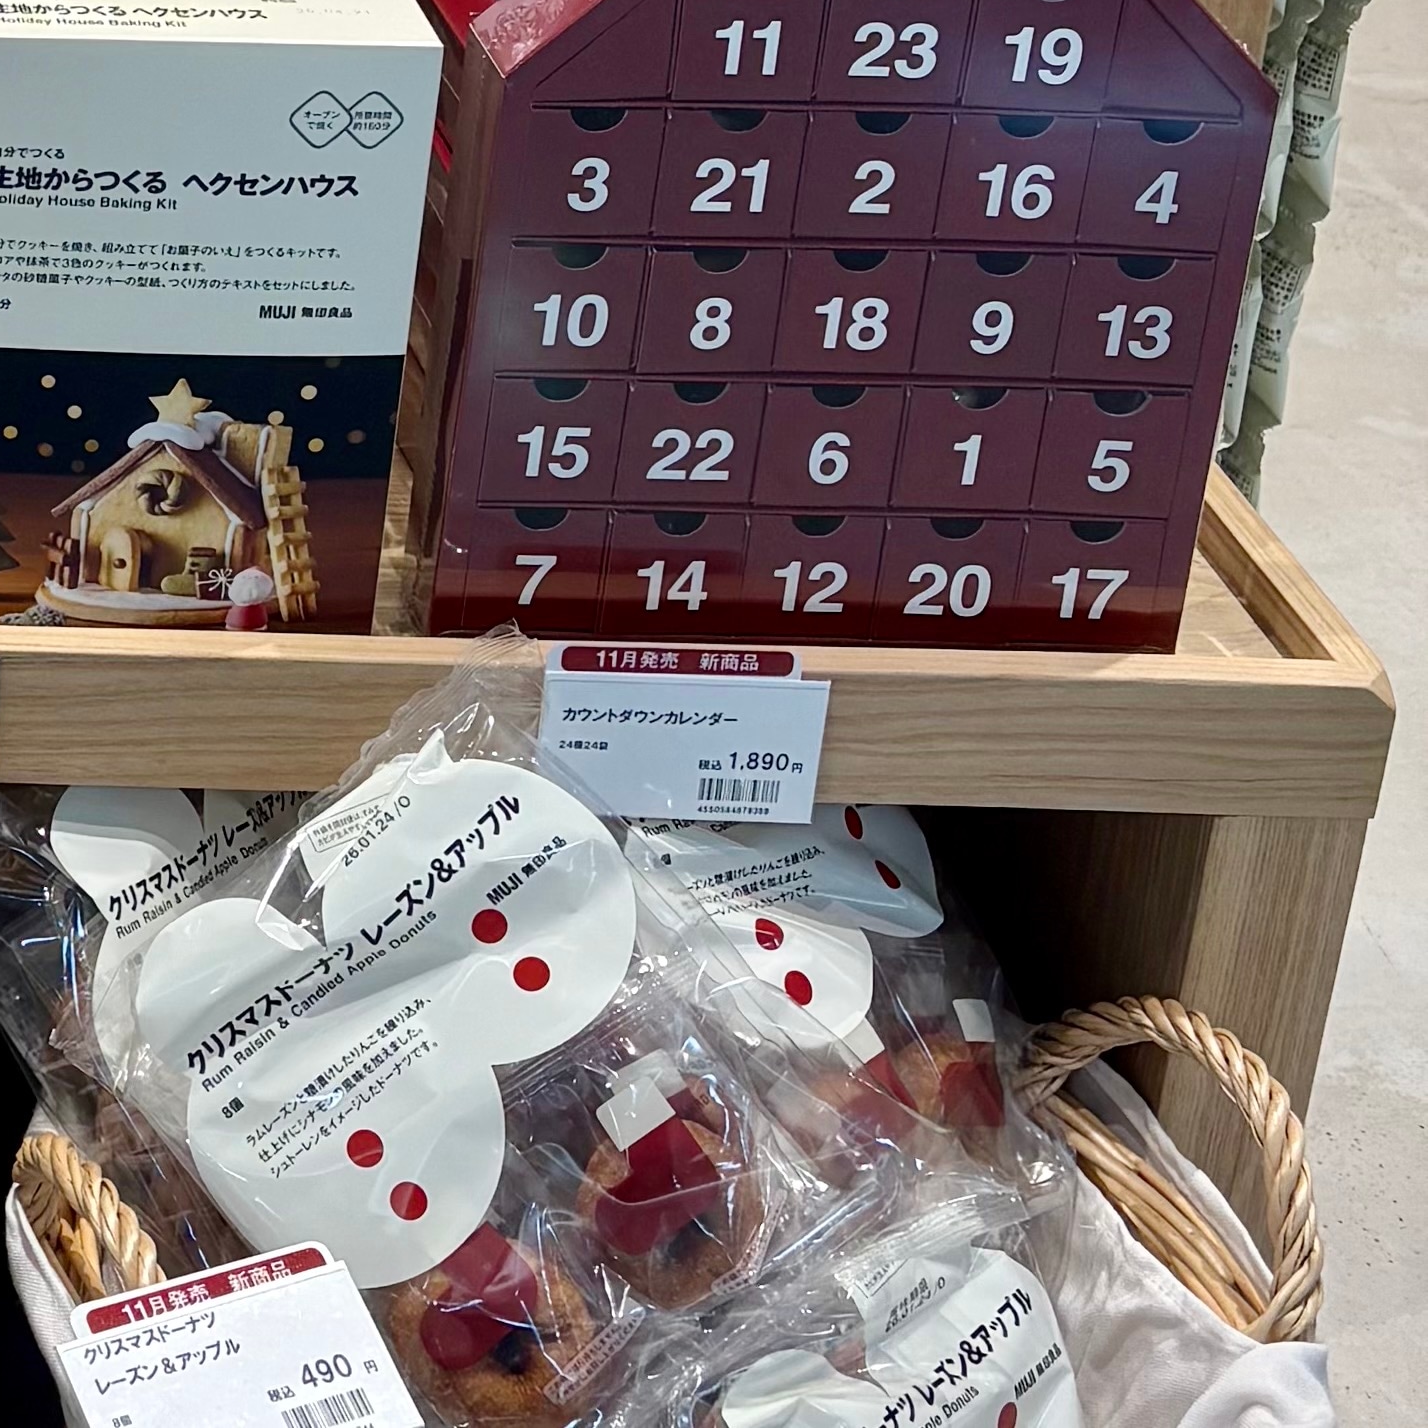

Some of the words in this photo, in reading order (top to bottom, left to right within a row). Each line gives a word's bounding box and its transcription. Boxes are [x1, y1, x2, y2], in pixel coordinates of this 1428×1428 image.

[714, 20, 783, 76] 11
[848, 22, 939, 79] 23
[1004, 26, 1084, 85] 19
[182, 169, 359, 199] ヘクセンハウス
[566, 157, 611, 213] 3
[690, 158, 773, 213] 21
[848, 160, 896, 214] 2
[977, 163, 1055, 220] 16
[1133, 170, 1180, 225] 4
[260, 304, 296, 320] MUJI
[533, 294, 609, 349] 10
[689, 298, 733, 351] 8
[813, 297, 889, 351] 18
[969, 300, 1015, 355] 9
[1097, 304, 1173, 359] 13
[514, 425, 591, 479] 15
[645, 428, 735, 482] 22
[807, 431, 851, 484] 6
[953, 434, 983, 486] 1
[1086, 439, 1133, 493] 5
[514, 555, 557, 605] 7
[637, 560, 708, 611] 14
[773, 560, 849, 614] 12
[903, 563, 993, 617] 20
[1050, 567, 1130, 620] 17
[596, 649, 680, 672] 11月発売
[699, 651, 759, 673] 新商品
[562, 705, 738, 726] カウントダウンカレンダー
[185, 939, 355, 1074] クリスマスドーナツ
[83, 1311, 218, 1364] クリスマスドーナツ
[300, 1353, 353, 1389] 490
